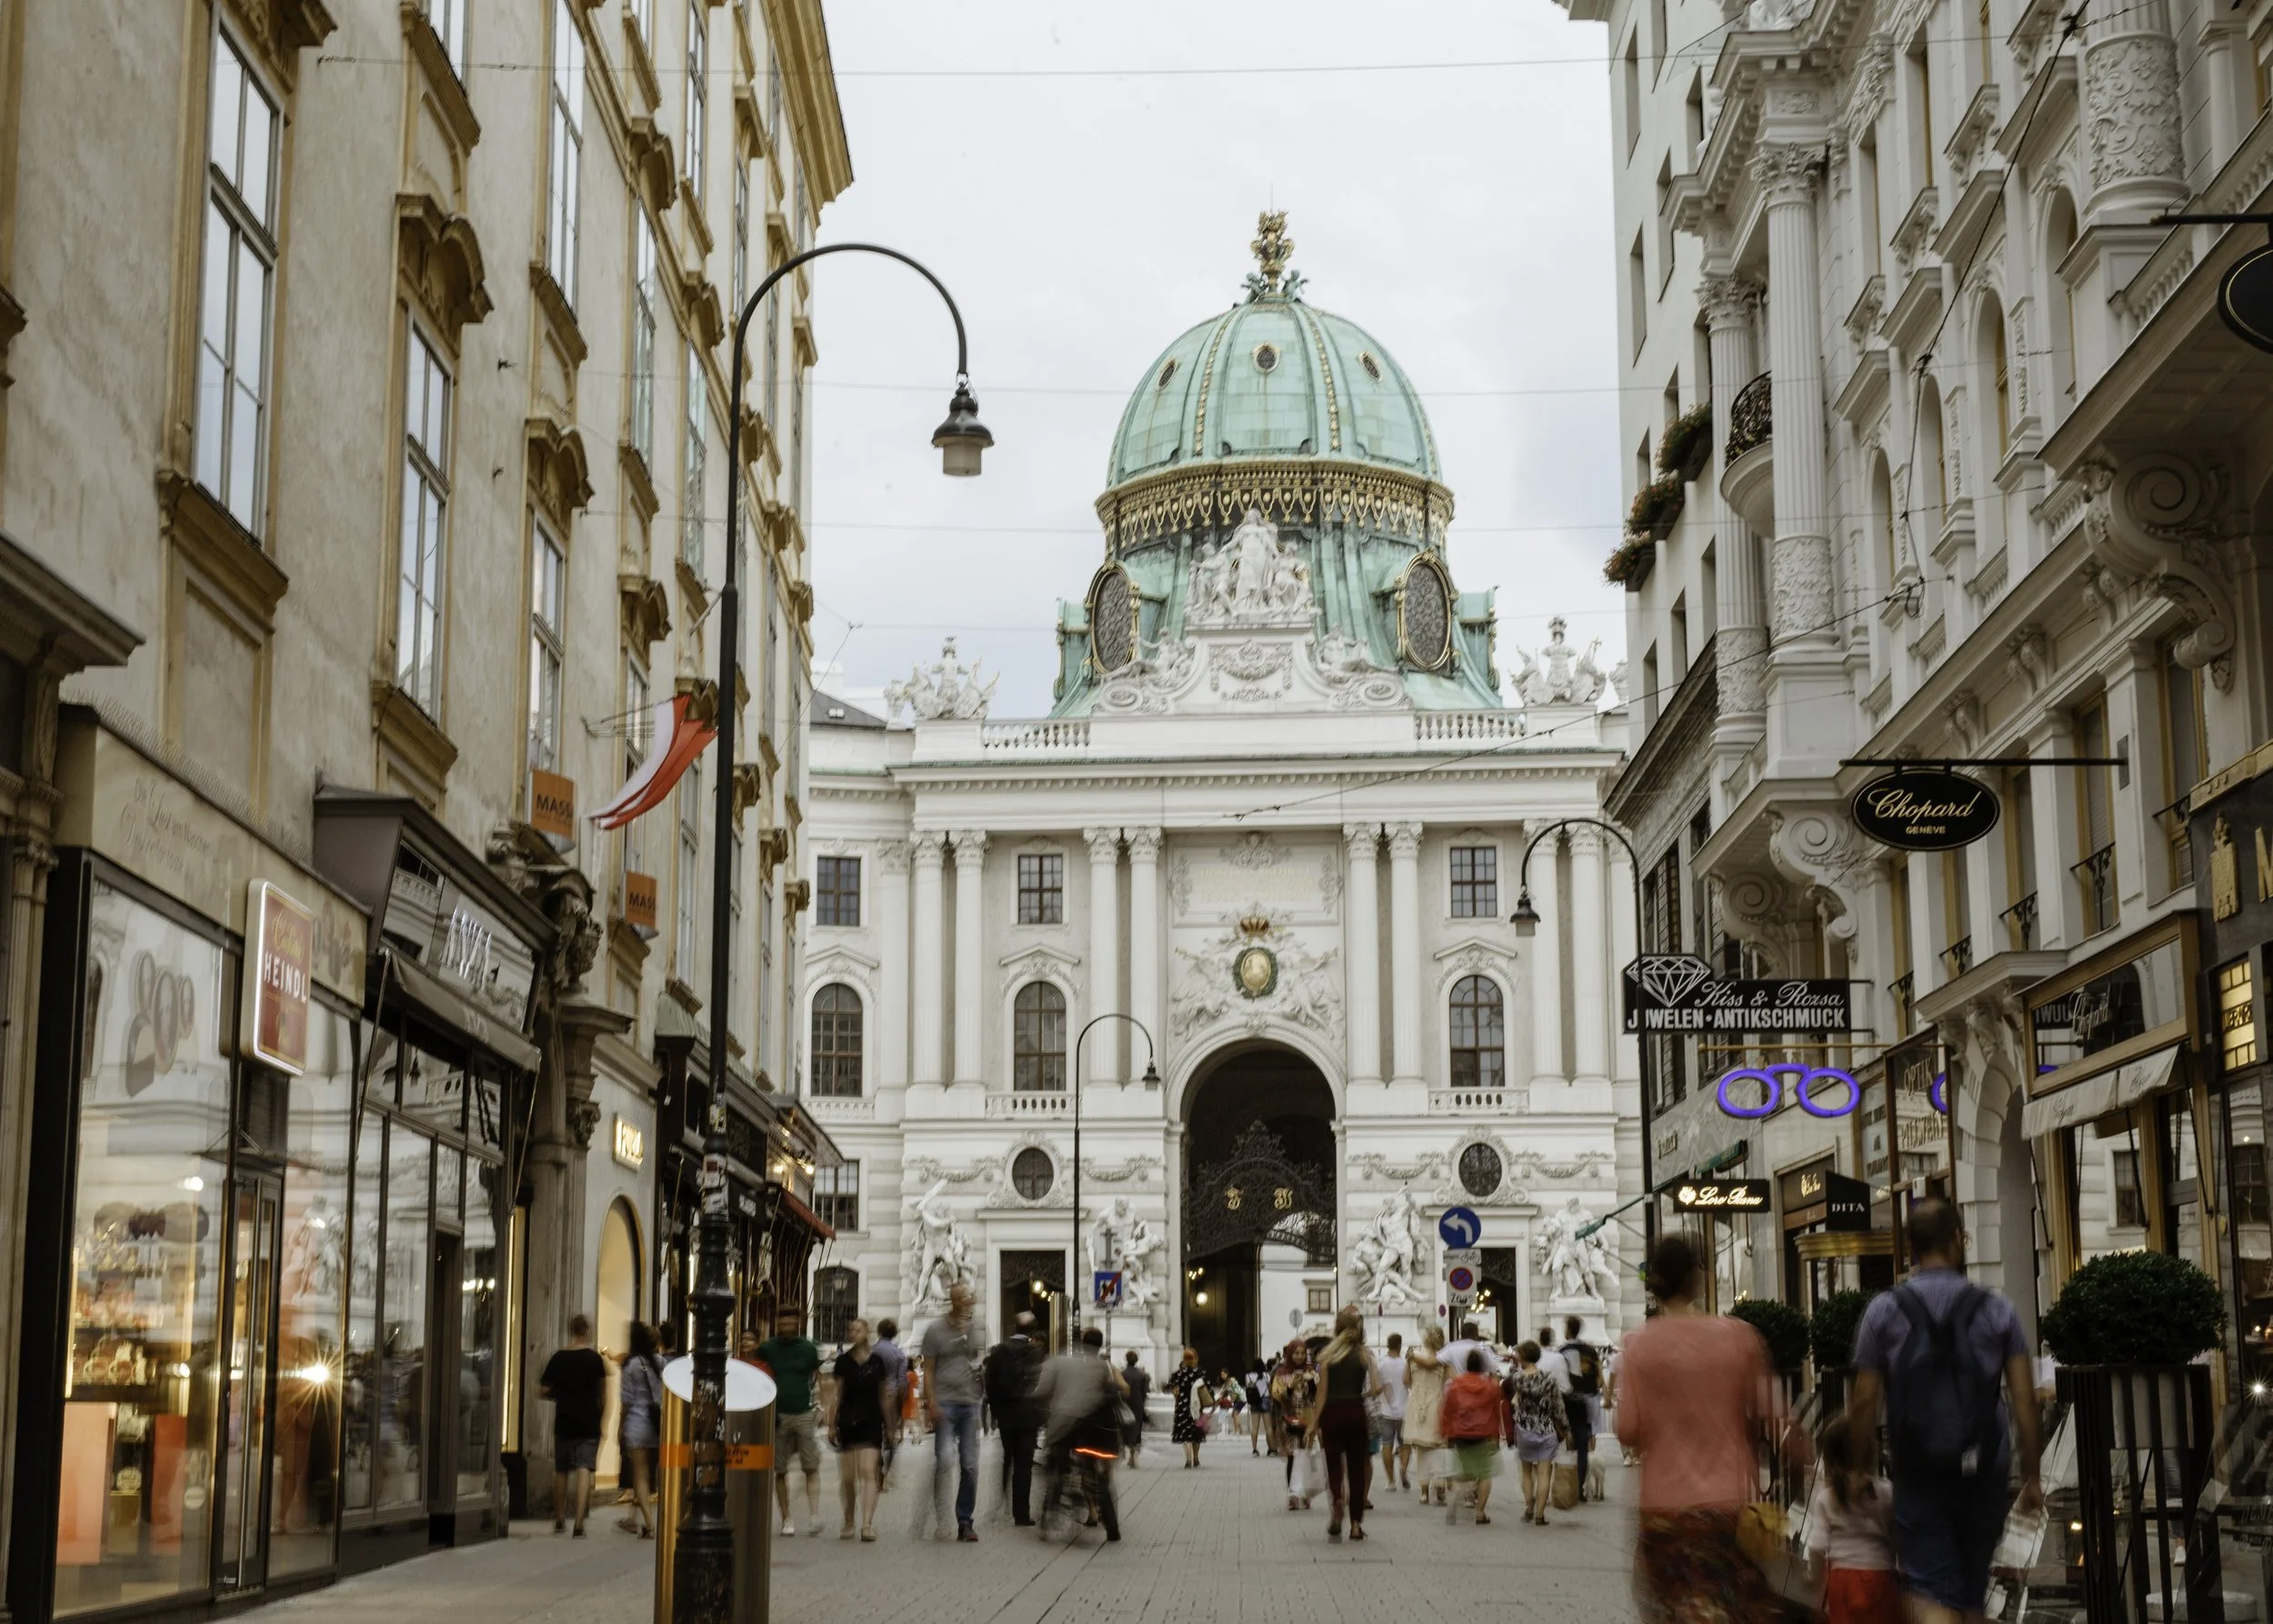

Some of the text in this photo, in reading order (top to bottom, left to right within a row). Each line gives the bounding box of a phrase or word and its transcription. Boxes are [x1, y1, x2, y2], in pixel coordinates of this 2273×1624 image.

[1867, 787, 1982, 824] Chopard
[263, 950, 307, 1004] HEINDL
[1695, 980, 1743, 1007] Kiss
[1750, 989, 1768, 1007] &
[1831, 1202, 1865, 1213] DITA
